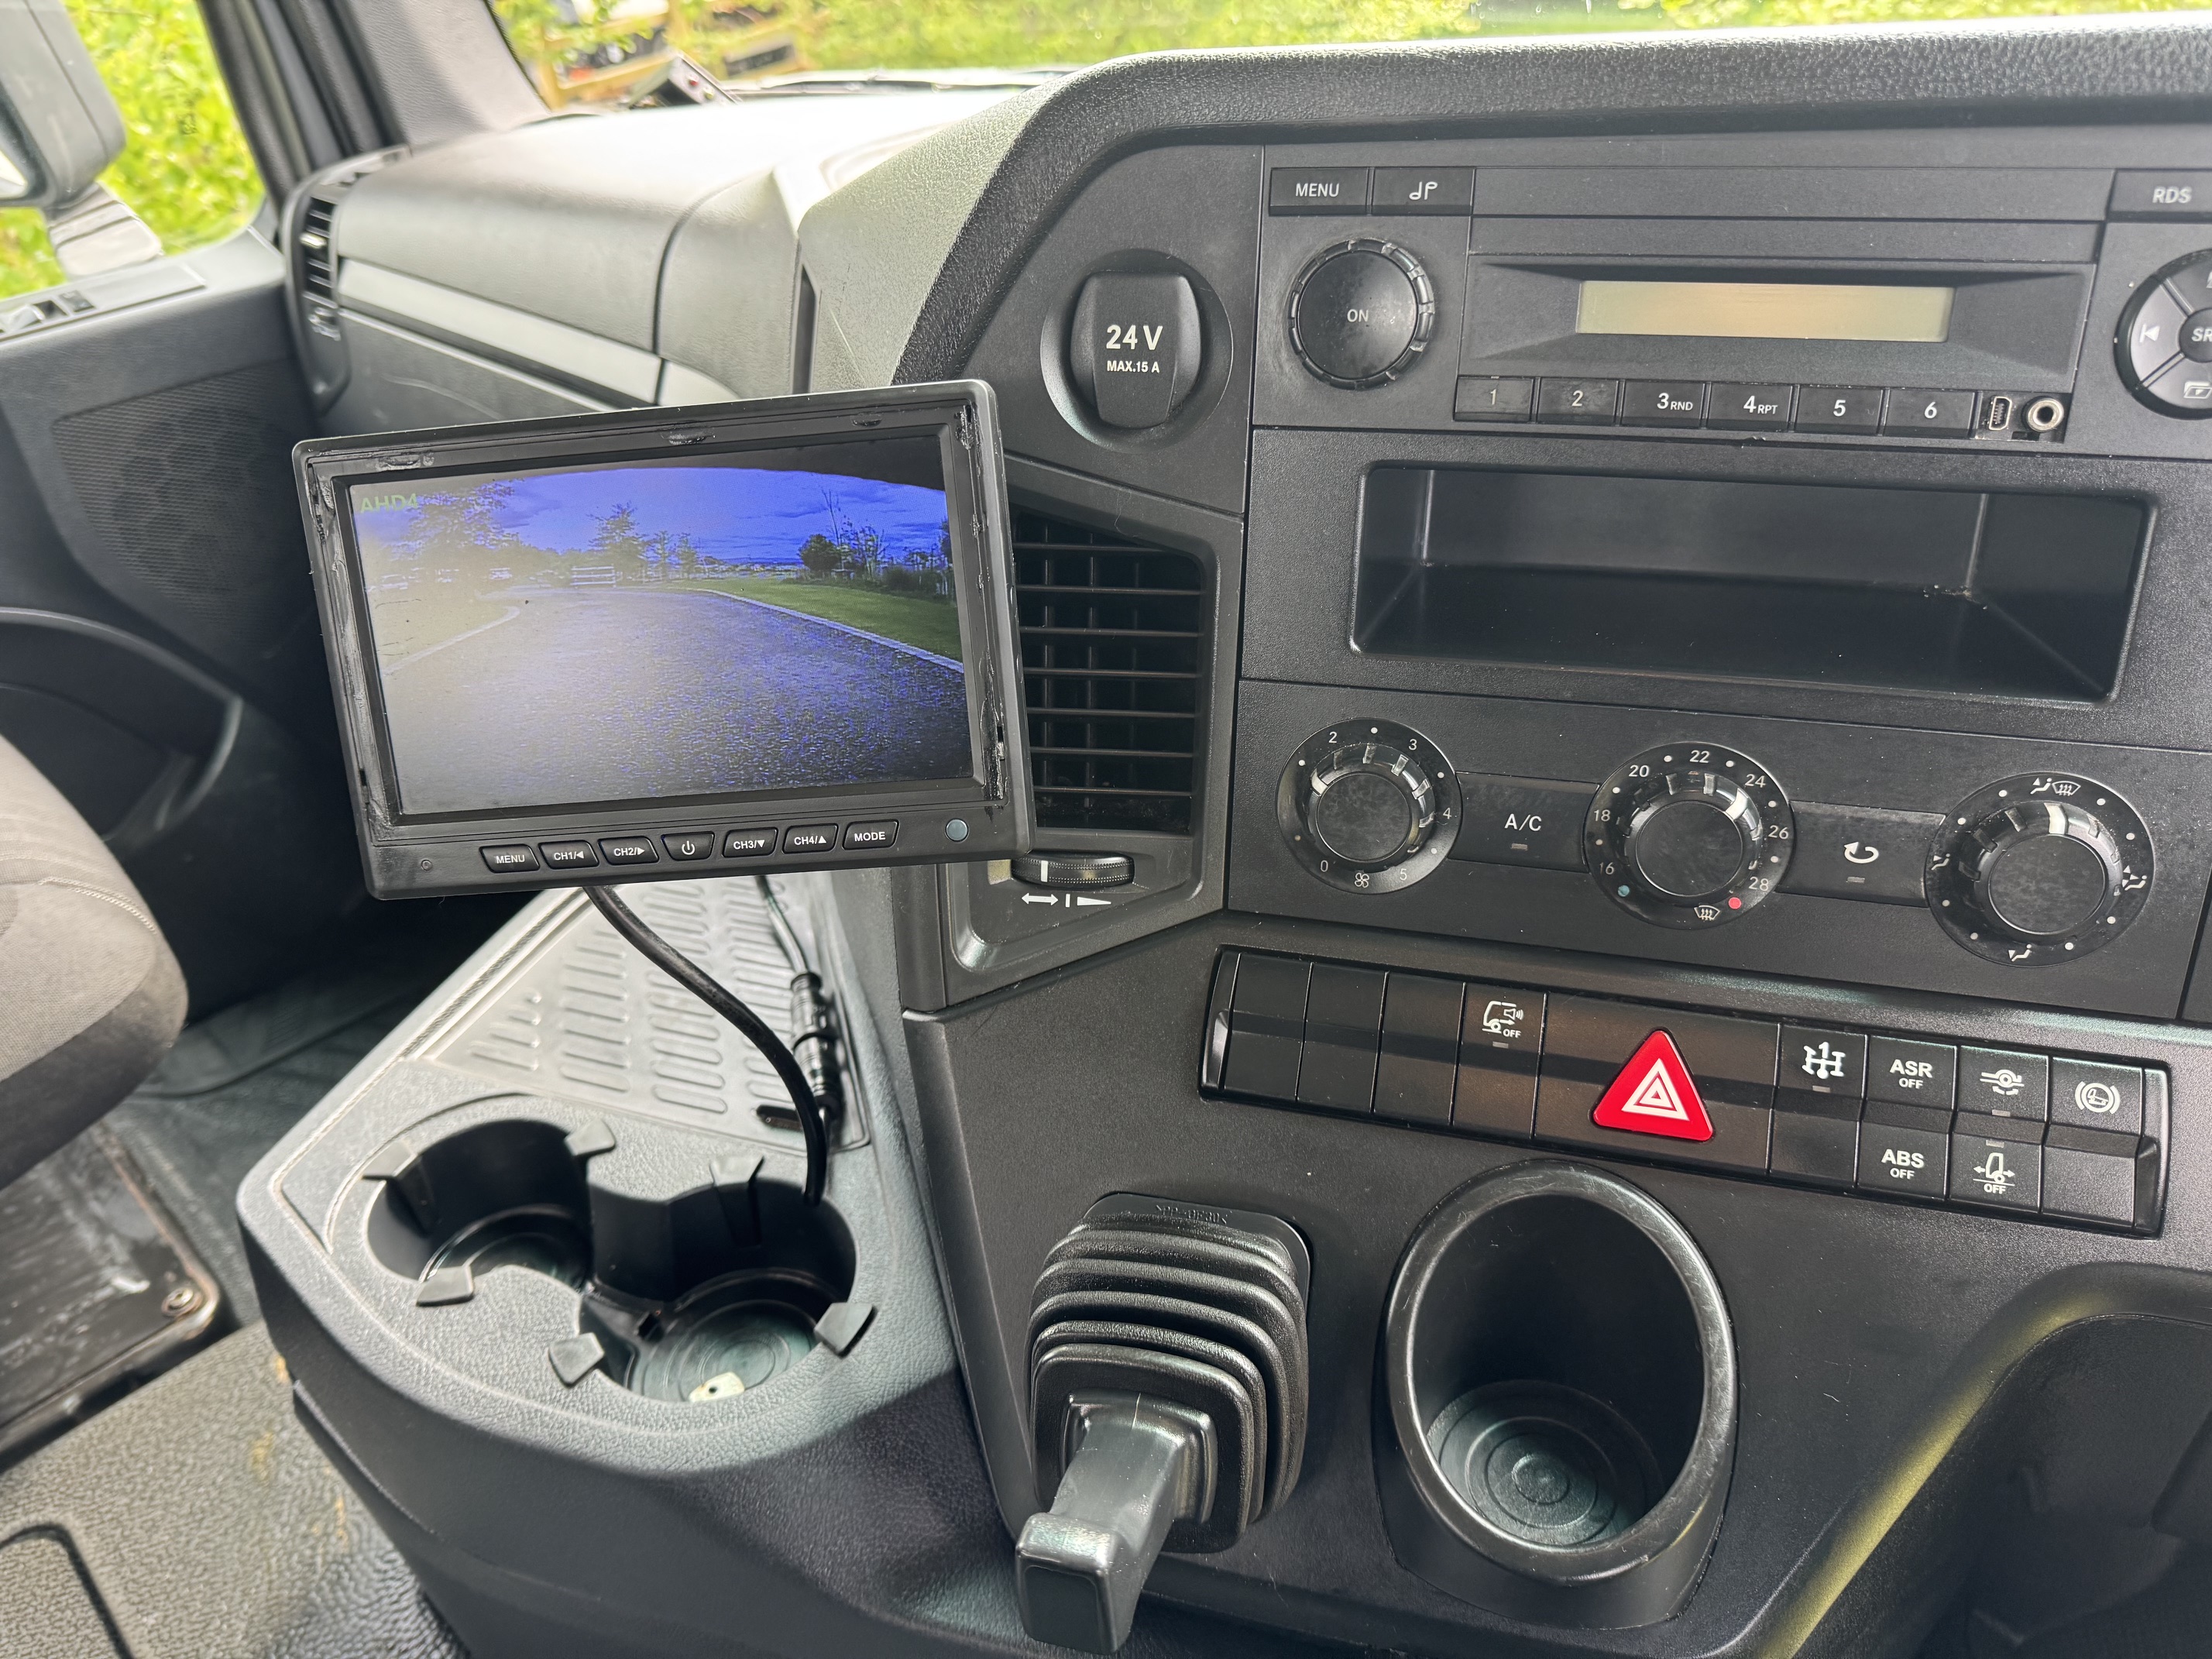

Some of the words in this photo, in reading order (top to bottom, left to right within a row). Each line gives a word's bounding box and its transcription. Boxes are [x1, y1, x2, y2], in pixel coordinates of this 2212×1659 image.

[1295, 182, 1340, 198] MENU
[2152, 186, 2193, 204] RDS
[1346, 308, 1369, 323] ON
[1489, 389, 1497, 406] 1
[1571, 390, 1585, 407] 2
[1832, 398, 1847, 417] 5
[1923, 400, 1938, 420] 6
[359, 493, 418, 514] AHD4
[1328, 731, 1338, 744] 2
[1407, 738, 1418, 750] 3
[1689, 749, 1710, 764] 22
[1628, 764, 1650, 778] 20
[1744, 773, 1767, 788] 24
[1442, 806, 1452, 820] 4
[1592, 809, 1611, 822] 18
[1504, 813, 1542, 832] A/C
[854, 831, 886, 842] MODE
[1767, 825, 1789, 840] 26
[496, 854, 525, 864] MENU
[1320, 859, 1329, 873] 0
[1399, 868, 1408, 882] 5
[1599, 861, 1615, 875] 16
[1748, 876, 1769, 892] 28
[1503, 1029, 1521, 1039] OFF
[1888, 1059, 1933, 1077] ASR
[1898, 1077, 1924, 1090] OFF
[1881, 1149, 1925, 1169] ABS
[1890, 1167, 1915, 1180] OFF
[1983, 1183, 2006, 1194] OFF
